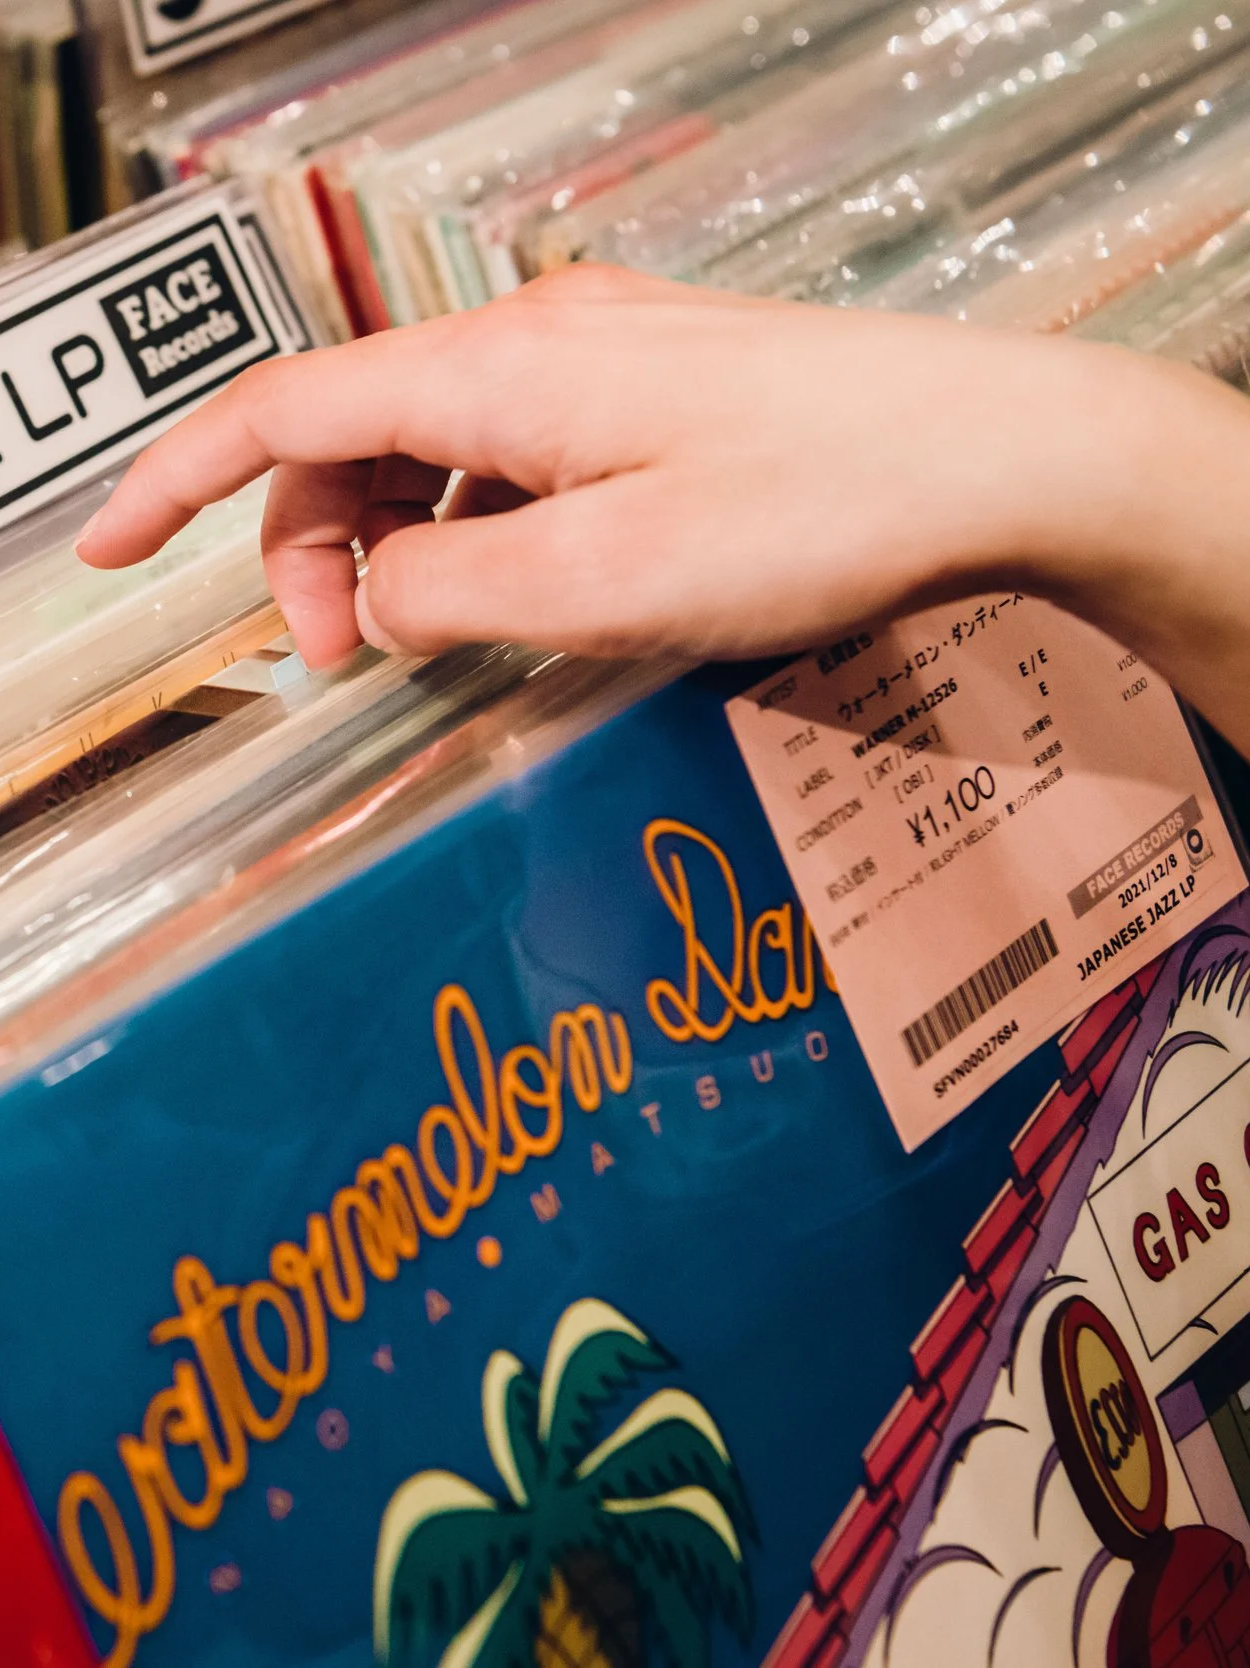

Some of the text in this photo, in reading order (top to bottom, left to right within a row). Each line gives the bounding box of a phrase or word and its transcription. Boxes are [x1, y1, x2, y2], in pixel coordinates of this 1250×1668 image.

[114, 258, 223, 342] FACE
[138, 308, 240, 379] Records
[0, 334, 105, 443] LP
[1037, 680, 1050, 698] E
[851, 713, 906, 760] WARNER
[795, 766, 835, 800] LABEL
[905, 765, 996, 848] ¥1,100
[795, 797, 864, 853] CONDITION
[1085, 811, 1186, 900] FACE RECORDS
[1117, 853, 1179, 909] 2021/12/8
[640, 818, 840, 1043] Da
[1077, 874, 1197, 982] JAPANESE JAZZ LP
[1133, 1162, 1230, 1282] GAS
